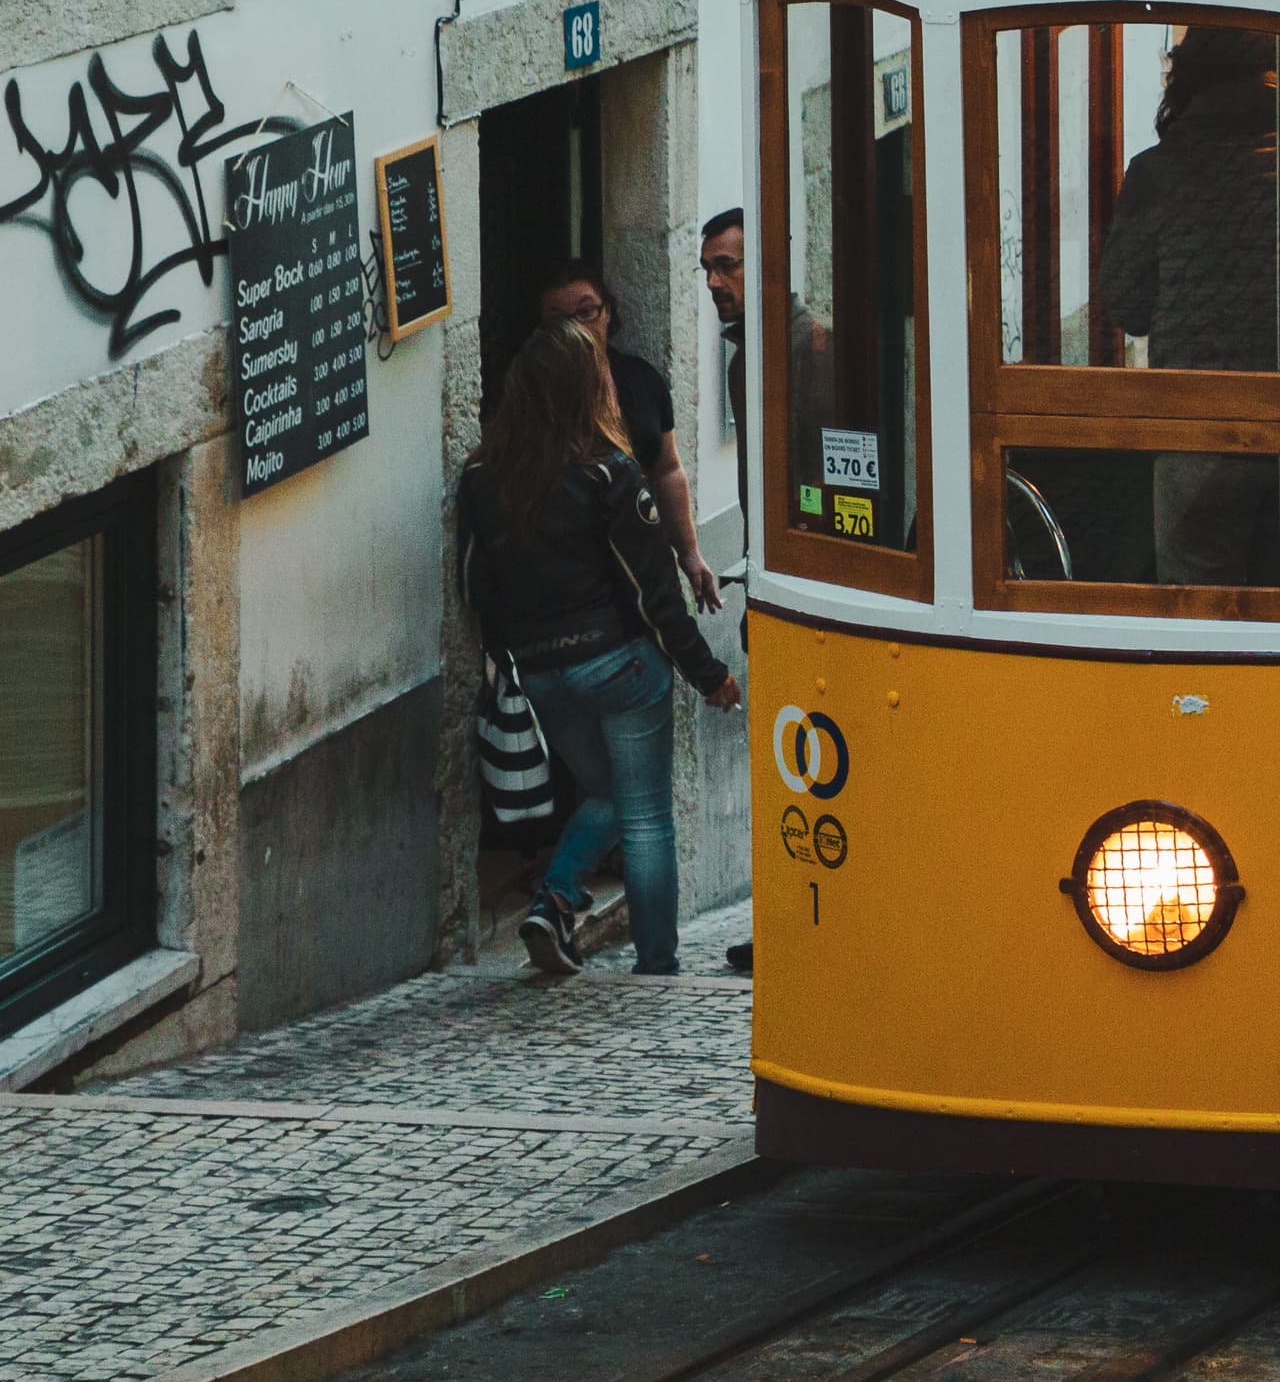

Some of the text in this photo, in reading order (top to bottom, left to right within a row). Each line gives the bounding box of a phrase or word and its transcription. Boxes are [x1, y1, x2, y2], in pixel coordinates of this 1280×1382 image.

[572, 12, 593, 59] 68
[234, 153, 298, 230] Happy
[301, 129, 350, 203] Hour
[312, 223, 352, 254] S M L
[237, 279, 272, 308] Super
[275, 260, 304, 292] Bock
[240, 307, 284, 344] Sangria
[241, 339, 298, 380] Sumersby
[244, 374, 297, 416] Cocktails
[245, 406, 302, 447] Caipirinha
[246, 452, 284, 485] Mojito
[826, 456, 876, 478] 3.70 €
[834, 512, 870, 536] 3.70
[809, 882, 818, 926] 1
